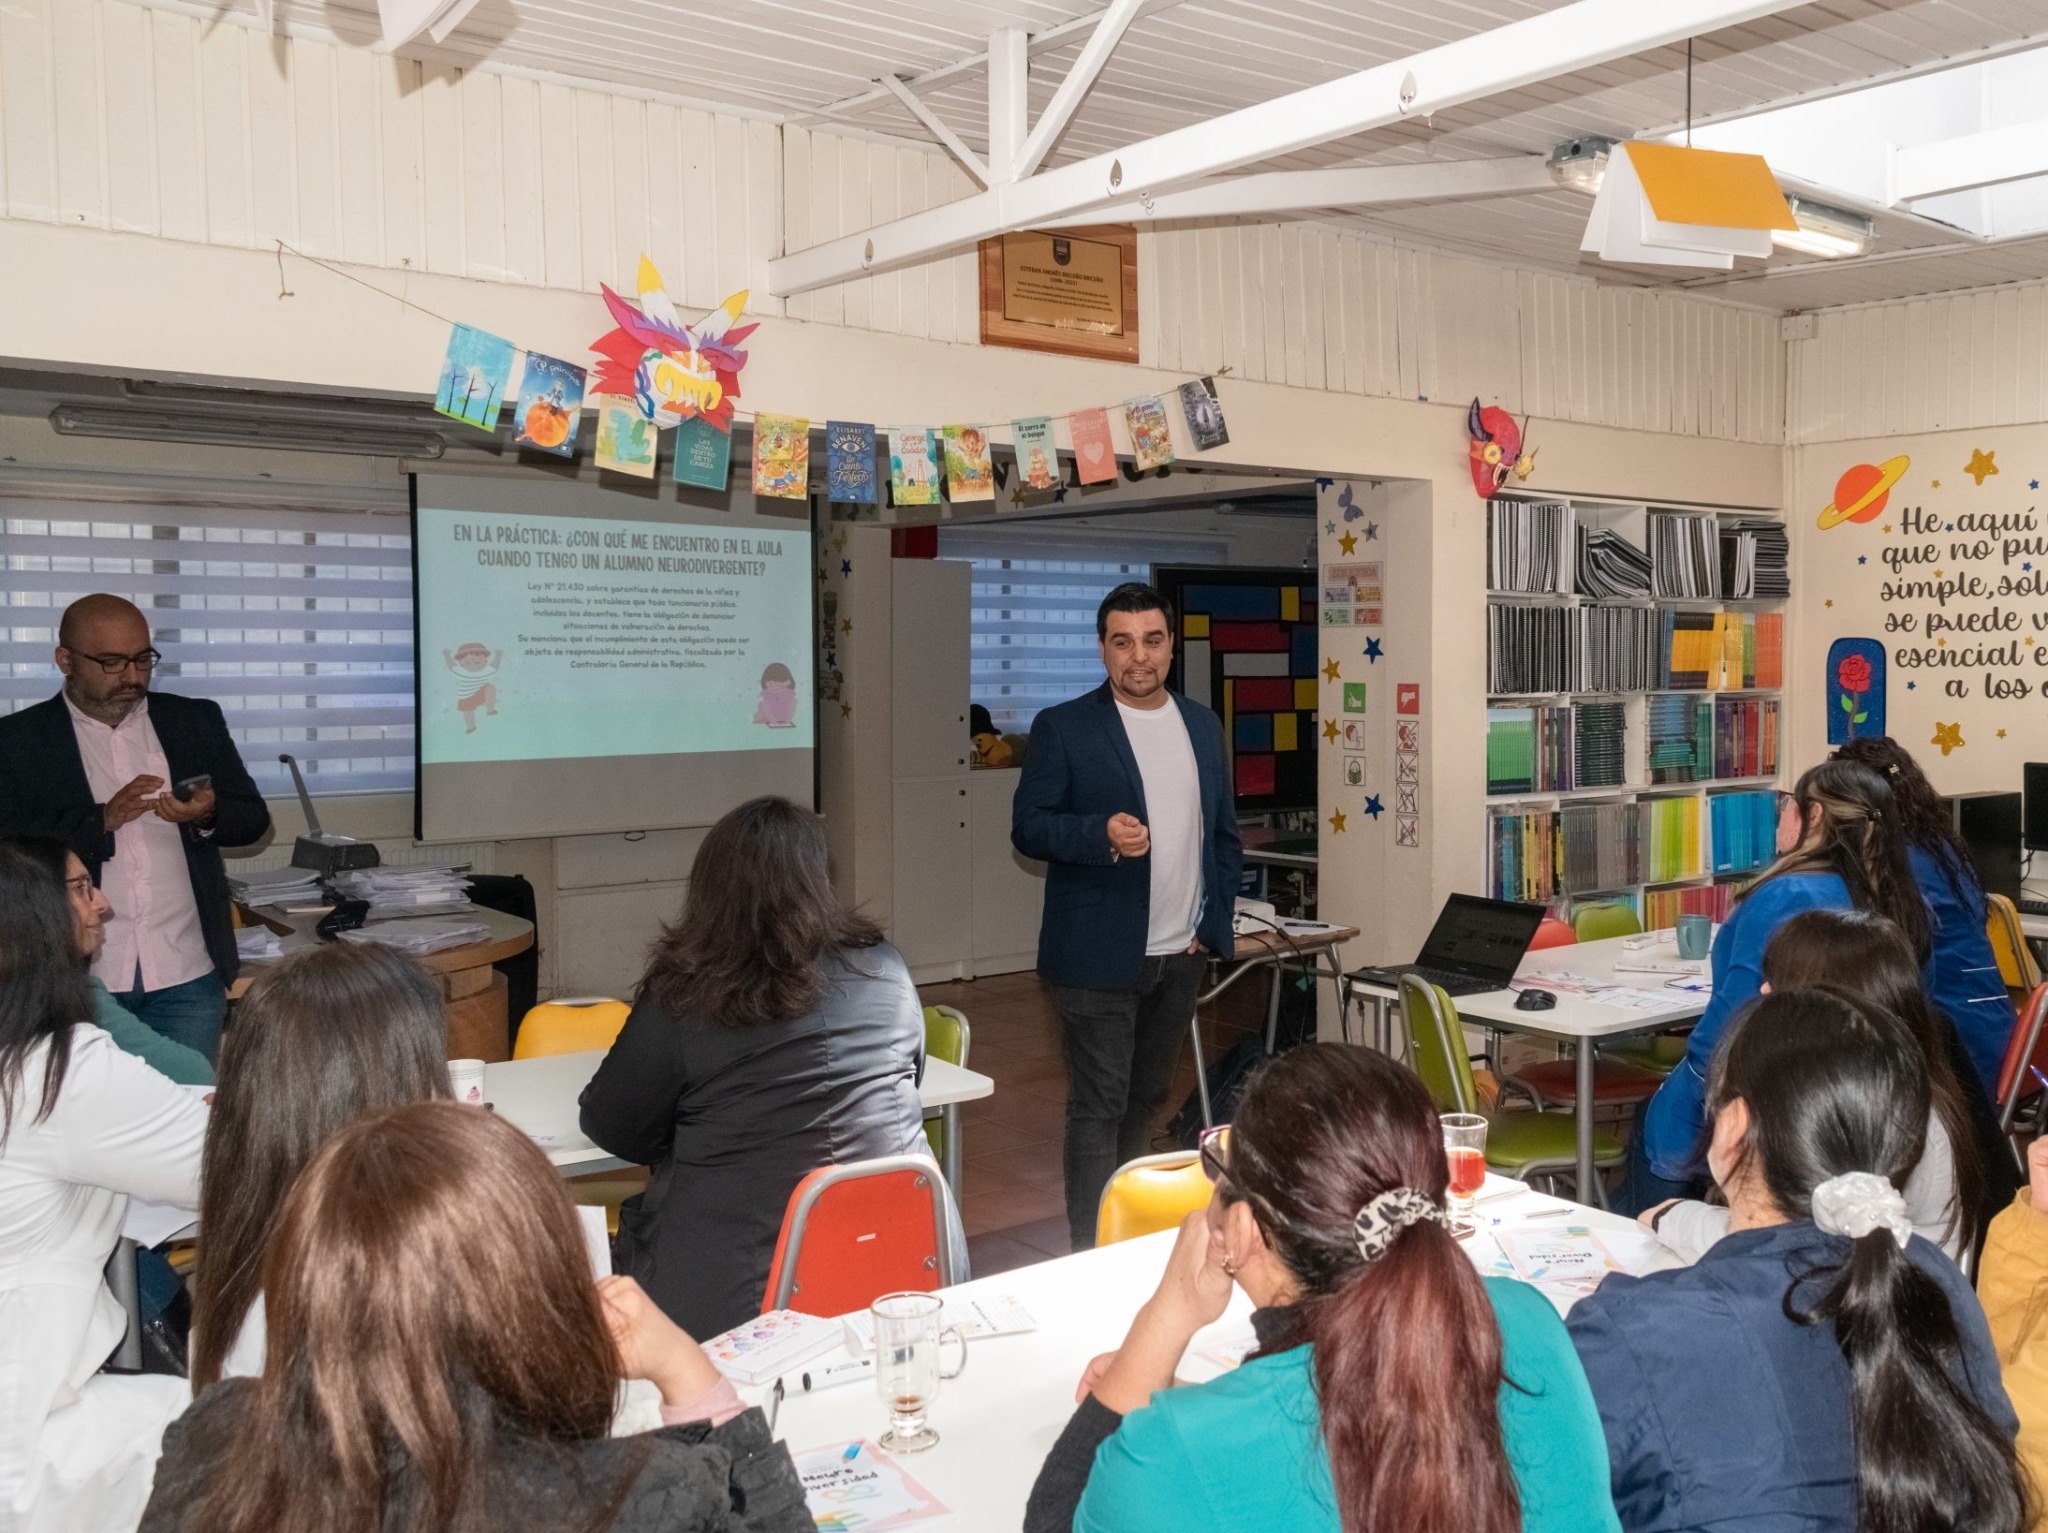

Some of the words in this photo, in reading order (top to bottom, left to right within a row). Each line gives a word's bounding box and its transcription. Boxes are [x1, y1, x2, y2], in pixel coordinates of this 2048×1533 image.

[836, 426, 865, 434] ELISABET
[694, 443, 713, 452] VIDAS
[699, 438, 710, 446] LAS
[832, 434, 870, 451] BENAVENT
[690, 448, 716, 458] DENTRO
[690, 459, 714, 469] CABEZA
[1900, 506, 1944, 535] He
[1957, 506, 2038, 541] aquí
[453, 524, 472, 542] EN
[476, 525, 492, 542] LA
[496, 523, 562, 546] PRÁCTICA:
[566, 530, 600, 548] ¿CON
[604, 528, 627, 549] QUÉ
[631, 533, 649, 550] ME
[653, 534, 720, 553] ENCUENTRO
[723, 538, 738, 554] EN
[741, 539, 753, 555] EL
[756, 540, 783, 556] AULA
[478, 549, 531, 567] CUANDO
[535, 551, 578, 569] TENGO
[582, 553, 600, 570] UN
[604, 554, 654, 572] ALUMNO
[658, 556, 766, 576] NEURODIVERGENTE?
[1882, 544, 1940, 574] que
[1950, 540, 1994, 560] no
[528, 582, 542, 592] Ley
[586, 584, 608, 592] sobre
[650, 586, 659, 594] de
[661, 586, 694, 594] derechos
[705, 588, 712, 596] la
[714, 588, 734, 596] niñez
[735, 590, 740, 598] y
[1880, 571, 1994, 607] simple,
[1998, 570, 2048, 596] sol
[653, 611, 690, 620] obligación
[702, 612, 736, 620] denunciar
[1884, 612, 1918, 633] se
[1926, 606, 2022, 640] puede
[563, 622, 608, 630] situaciones
[610, 622, 620, 630] de
[621, 622, 665, 630] vulneración
[518, 634, 528, 642] Se
[570, 636, 583, 644] que
[594, 636, 648, 644] incumplimiento
[680, 636, 714, 645] obligación
[716, 636, 737, 645] puede
[524, 648, 552, 656] objeto
[554, 648, 564, 656] de
[566, 648, 625, 656] responsabilidad
[1895, 640, 2024, 668] esencial
[619, 660, 648, 668] General
[1945, 679, 1969, 698] a
[1984, 672, 2033, 700] los
[806, 1472, 879, 1491] iversidad
